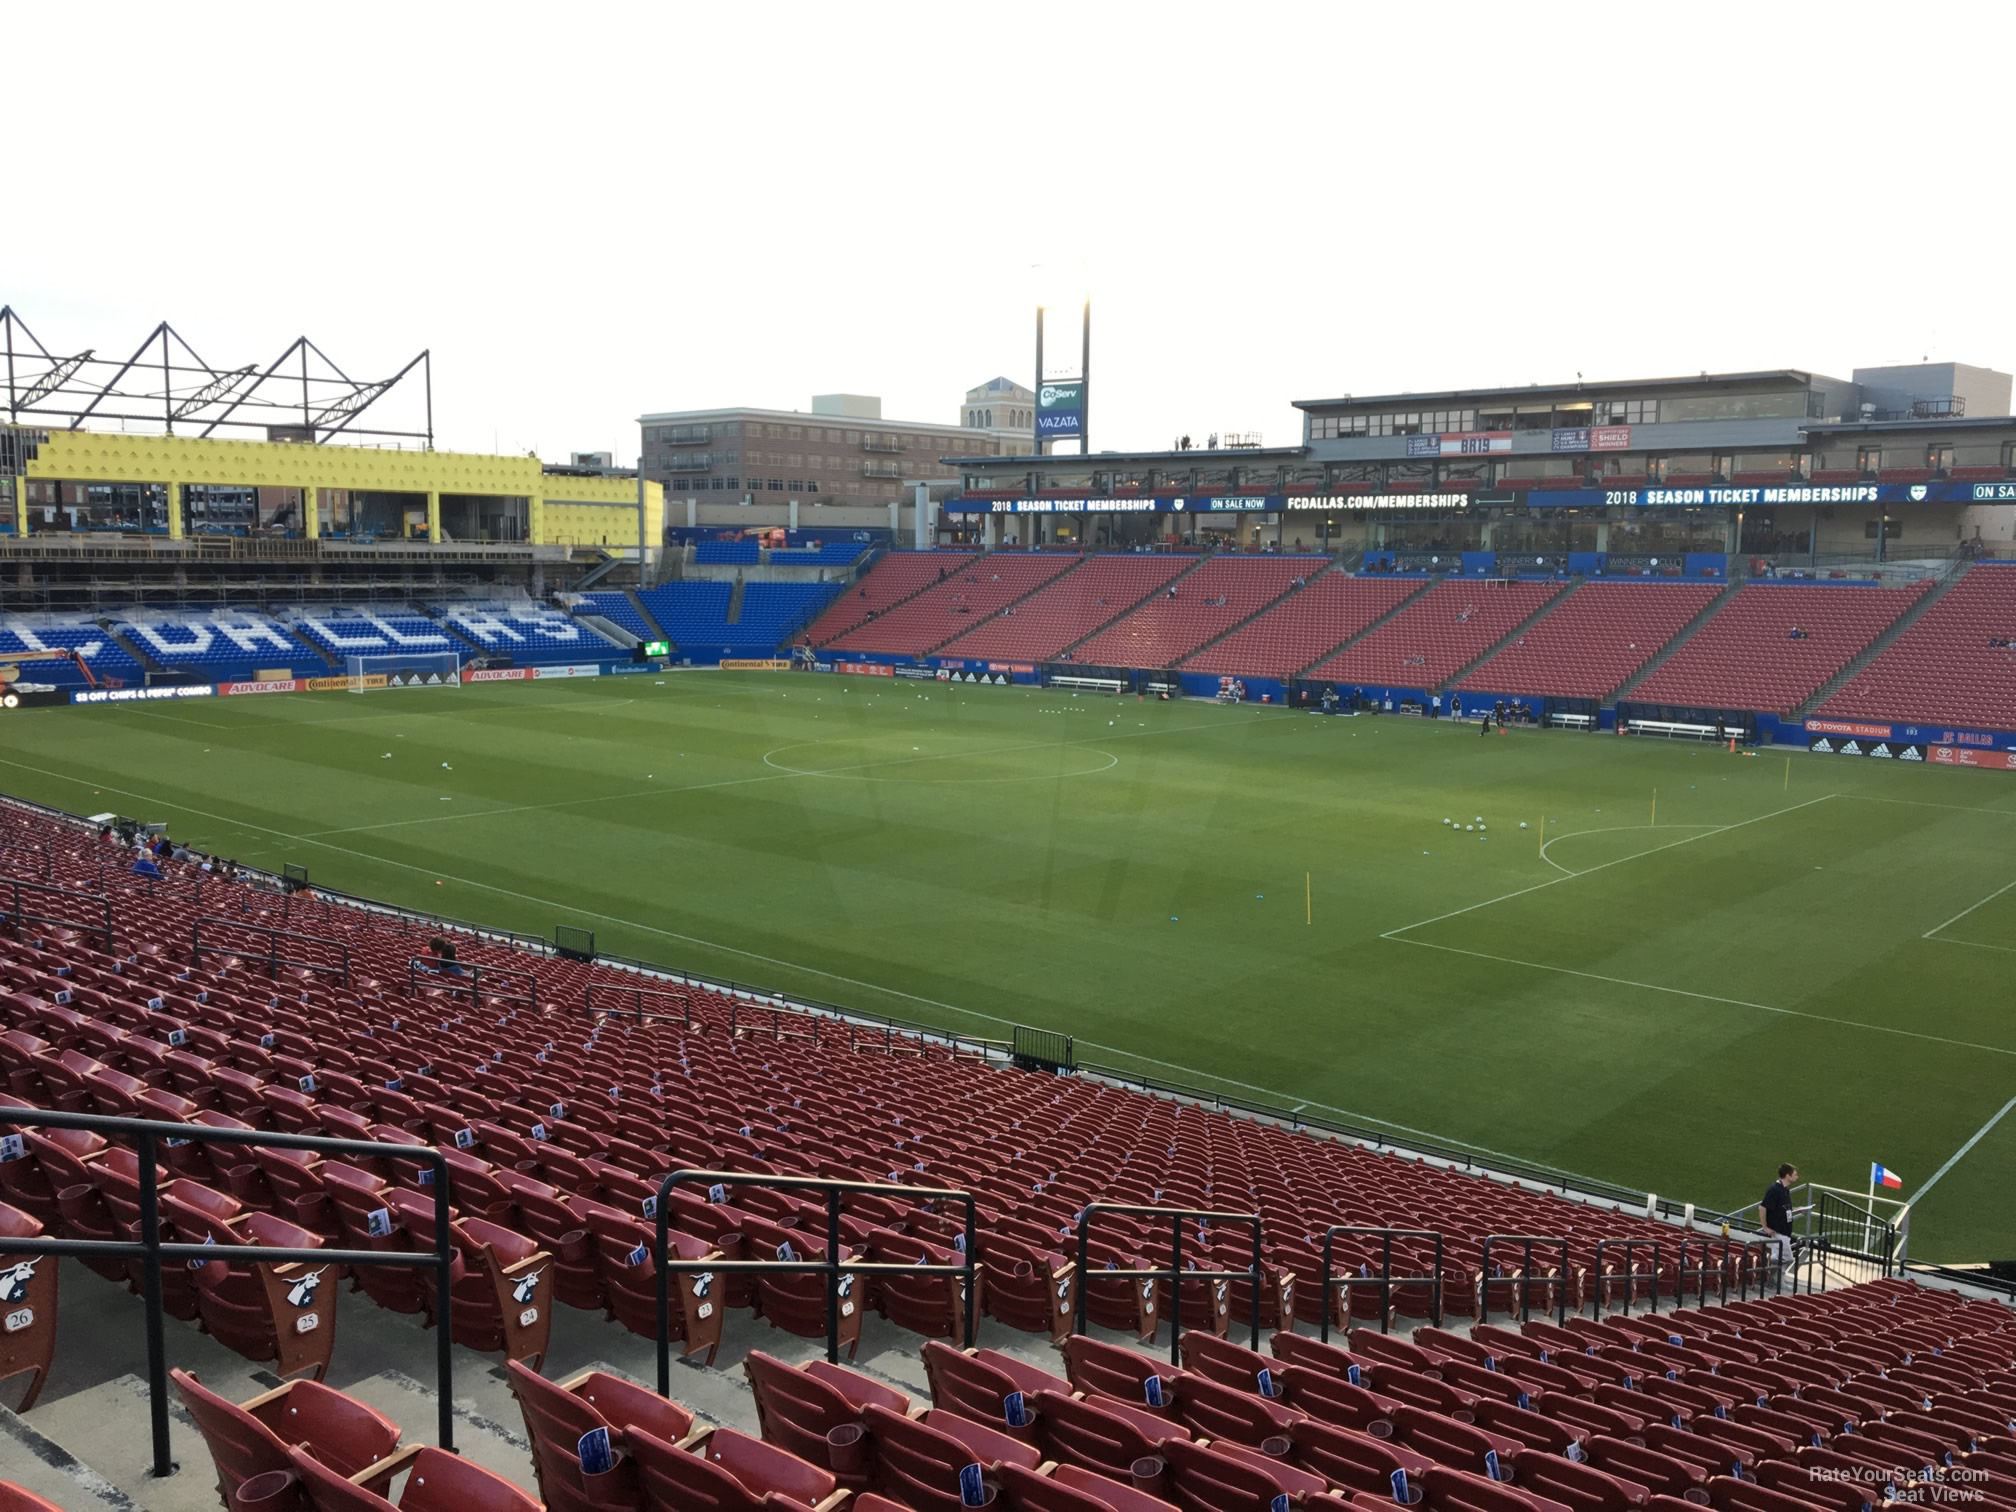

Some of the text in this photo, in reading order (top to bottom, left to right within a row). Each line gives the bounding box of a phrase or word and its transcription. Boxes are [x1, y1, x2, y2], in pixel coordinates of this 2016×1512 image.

[1042, 390, 1077, 399] CoServ
[1038, 416, 1078, 428] VAZATA
[1461, 439, 1490, 453] BR19
[1606, 487, 1878, 504] 2018 SEASON TICKET MEMBERSHIPS
[1976, 486, 2016, 498] ON SA
[992, 500, 1155, 512] 2018 SEASON TICKET MEMBERSHIPS
[1212, 498, 1264, 509] ON SALE NOW
[1288, 494, 1468, 509] FCDALLAS.COM/MEMBERSHIPS
[721, 660, 763, 669] Continental
[471, 669, 525, 681] ADVOCARE
[228, 680, 296, 694] ADVOCARE
[88, 691, 108, 701] OFF
[109, 690, 137, 700] CHIPS
[138, 689, 146, 699] &
[177, 686, 212, 697] COMBO
[1823, 724, 1890, 735] TOYOTA STADIUM
[1943, 732, 1993, 745] FC DALLAS
[701, 1305, 710, 1316] 23
[10, 1311, 28, 1327] 26
[301, 1315, 314, 1330] 25
[523, 1311, 534, 1324] 24
